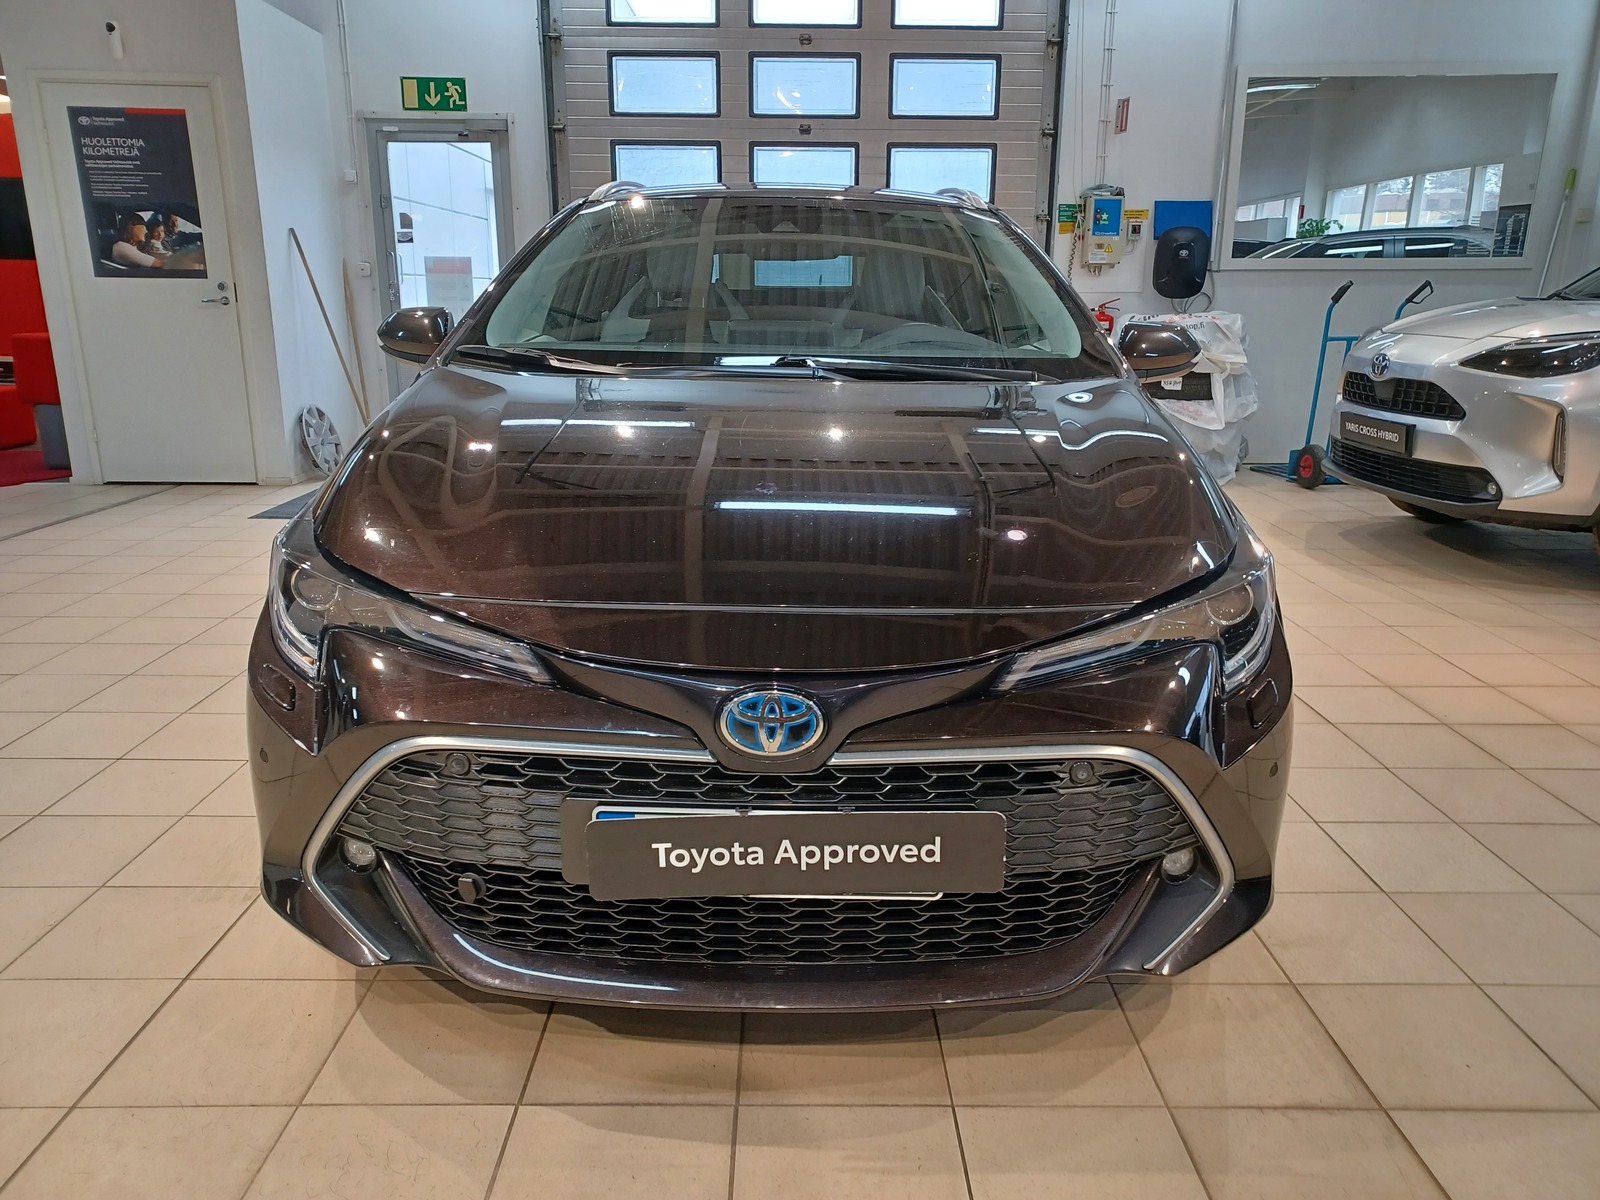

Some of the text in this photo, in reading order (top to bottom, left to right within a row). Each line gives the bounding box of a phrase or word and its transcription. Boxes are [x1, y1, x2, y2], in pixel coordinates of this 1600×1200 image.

[81, 137, 145, 147] HUOLETTOMIA
[82, 146, 140, 156] KILOMETREJÄ
[1185, 321, 1205, 331] top.fi
[1345, 422, 1399, 443] YARIS CROSS HYBRID
[651, 837, 941, 873] Toyota Approved
